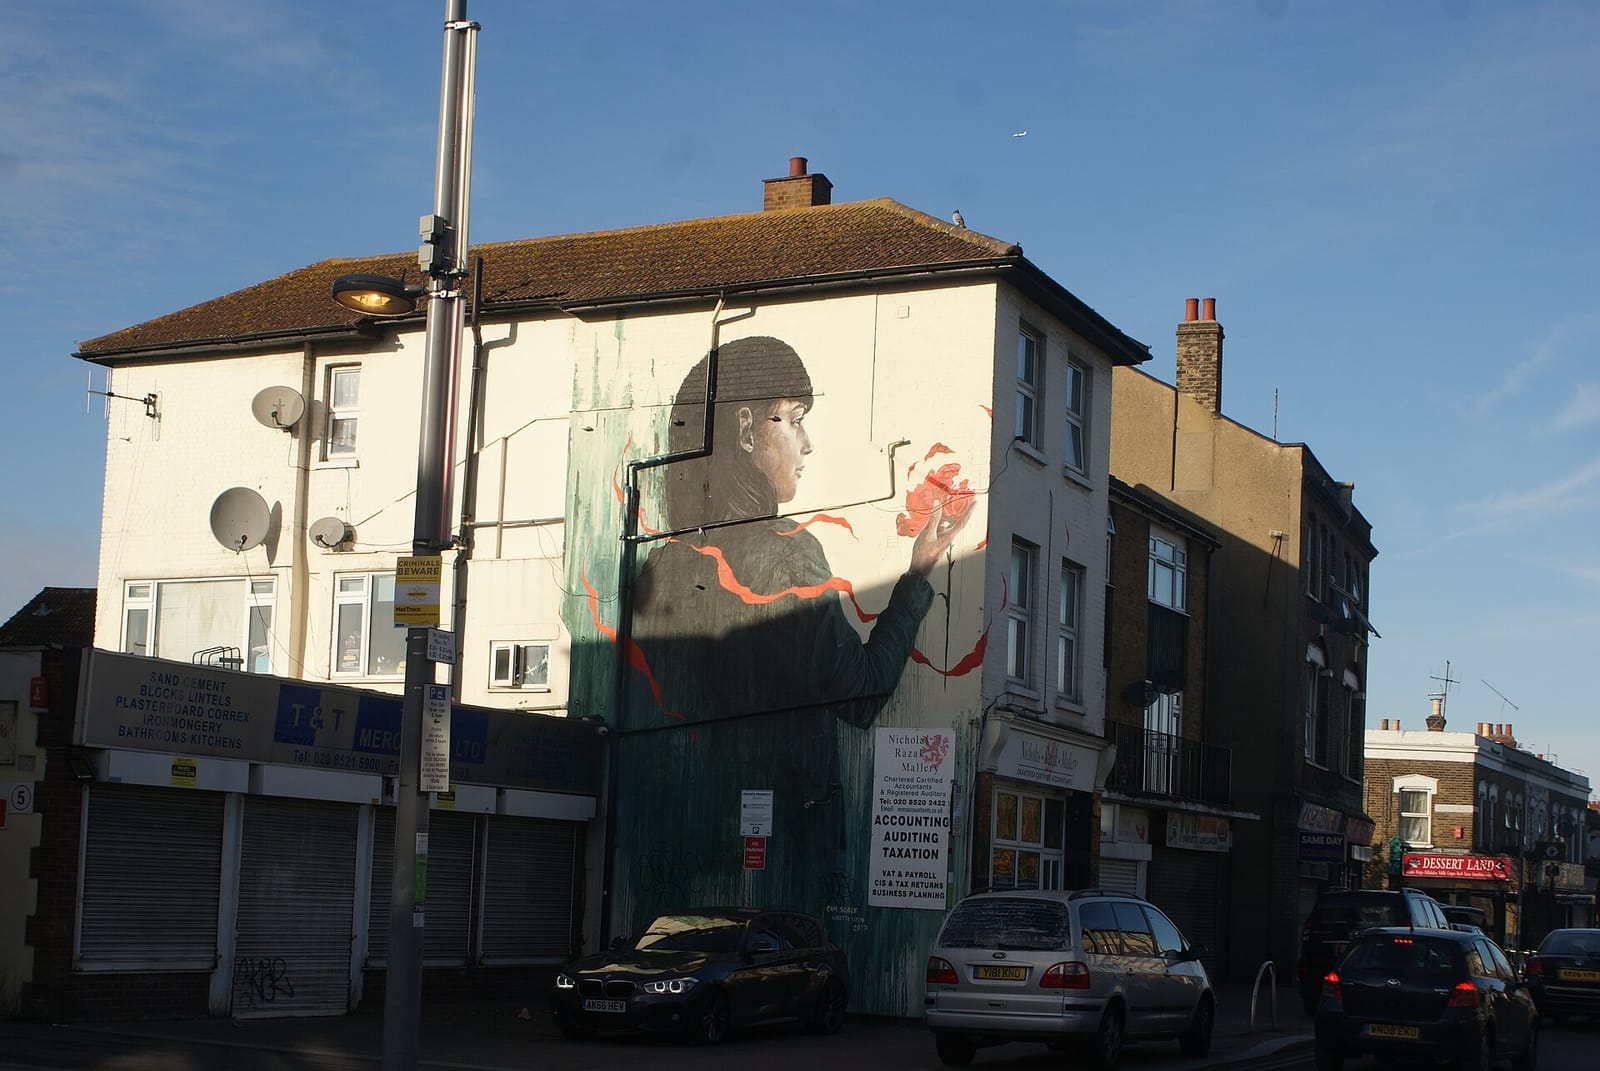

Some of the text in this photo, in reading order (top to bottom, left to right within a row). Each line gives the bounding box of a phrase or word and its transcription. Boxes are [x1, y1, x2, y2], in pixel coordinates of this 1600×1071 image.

[397, 567, 439, 576] BEWARE
[150, 671, 227, 692] SAND CEMENT
[140, 684, 232, 707] BLOCKS LINTELS
[115, 696, 249, 722] PLASTERBOARD CORREX
[143, 714, 222, 733] IRONMONGERY
[291, 703, 345, 732] T & T
[118, 725, 242, 749] BATHROOMS KITCHENS
[293, 750, 309, 763] Tel:
[313, 752, 330, 766] 020
[334, 754, 356, 768] 8521
[902, 762, 938, 775] Mallery
[895, 782, 932, 790] Accountants
[17, 791, 25, 805] 5
[886, 789, 919, 797] Registered
[921, 790, 946, 798] Auditors
[874, 815, 949, 828] ACCOUNTING
[884, 831, 939, 844] AUDITING
[1301, 835, 1343, 845] SAME DAY
[882, 847, 939, 859] TAXATION
[1423, 857, 1494, 871] DESSERT LAND
[904, 871, 937, 879] PAYROLL
[874, 879, 886, 887] CIS
[895, 880, 909, 888] TAX
[911, 881, 944, 889] RETURNS
[872, 889, 945, 899] BUSINESS PLANNING
[587, 1000, 625, 1010] AK66 HEV
